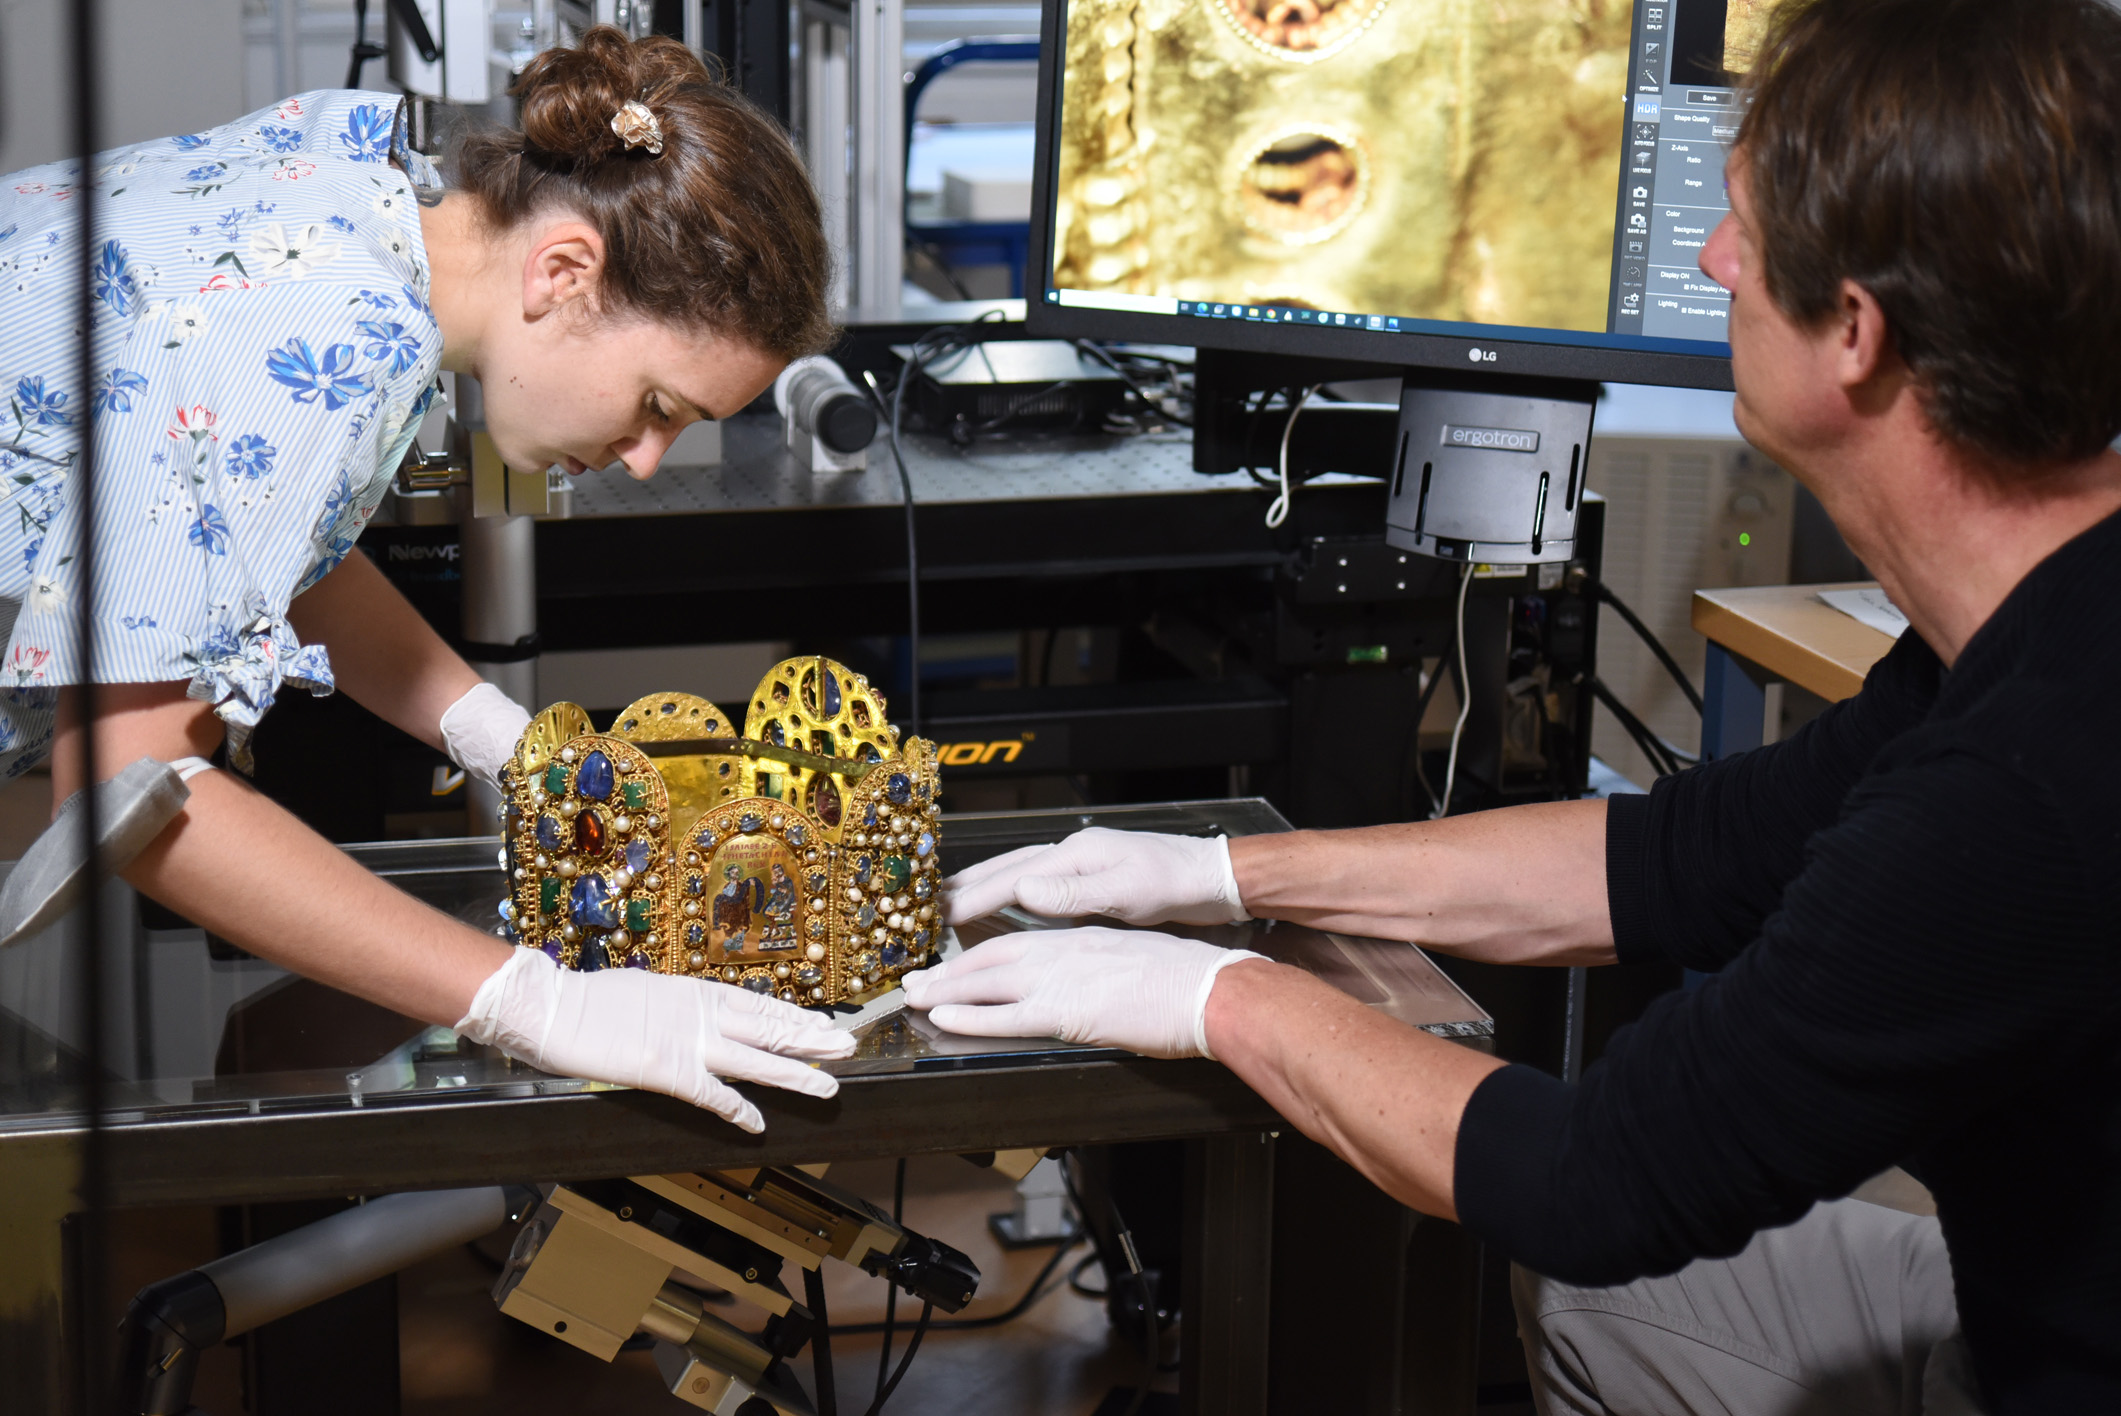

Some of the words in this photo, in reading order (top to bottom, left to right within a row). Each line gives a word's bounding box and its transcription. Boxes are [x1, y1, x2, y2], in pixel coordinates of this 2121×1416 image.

[1702, 94, 1717, 102] Save
[1637, 104, 1658, 114] HDR
[1674, 114, 1691, 122] Shape
[1692, 115, 1710, 123] Quality
[1685, 179, 1702, 187] Range
[1673, 226, 1704, 234] Background
[1672, 239, 1701, 247] Coordinate
[1661, 271, 1680, 280] Display
[1699, 284, 1718, 293] Display
[1658, 300, 1678, 308] Lighting
[1706, 309, 1726, 317] Lighting
[1482, 350, 1497, 361] LG
[1453, 429, 1531, 448] ergotron
